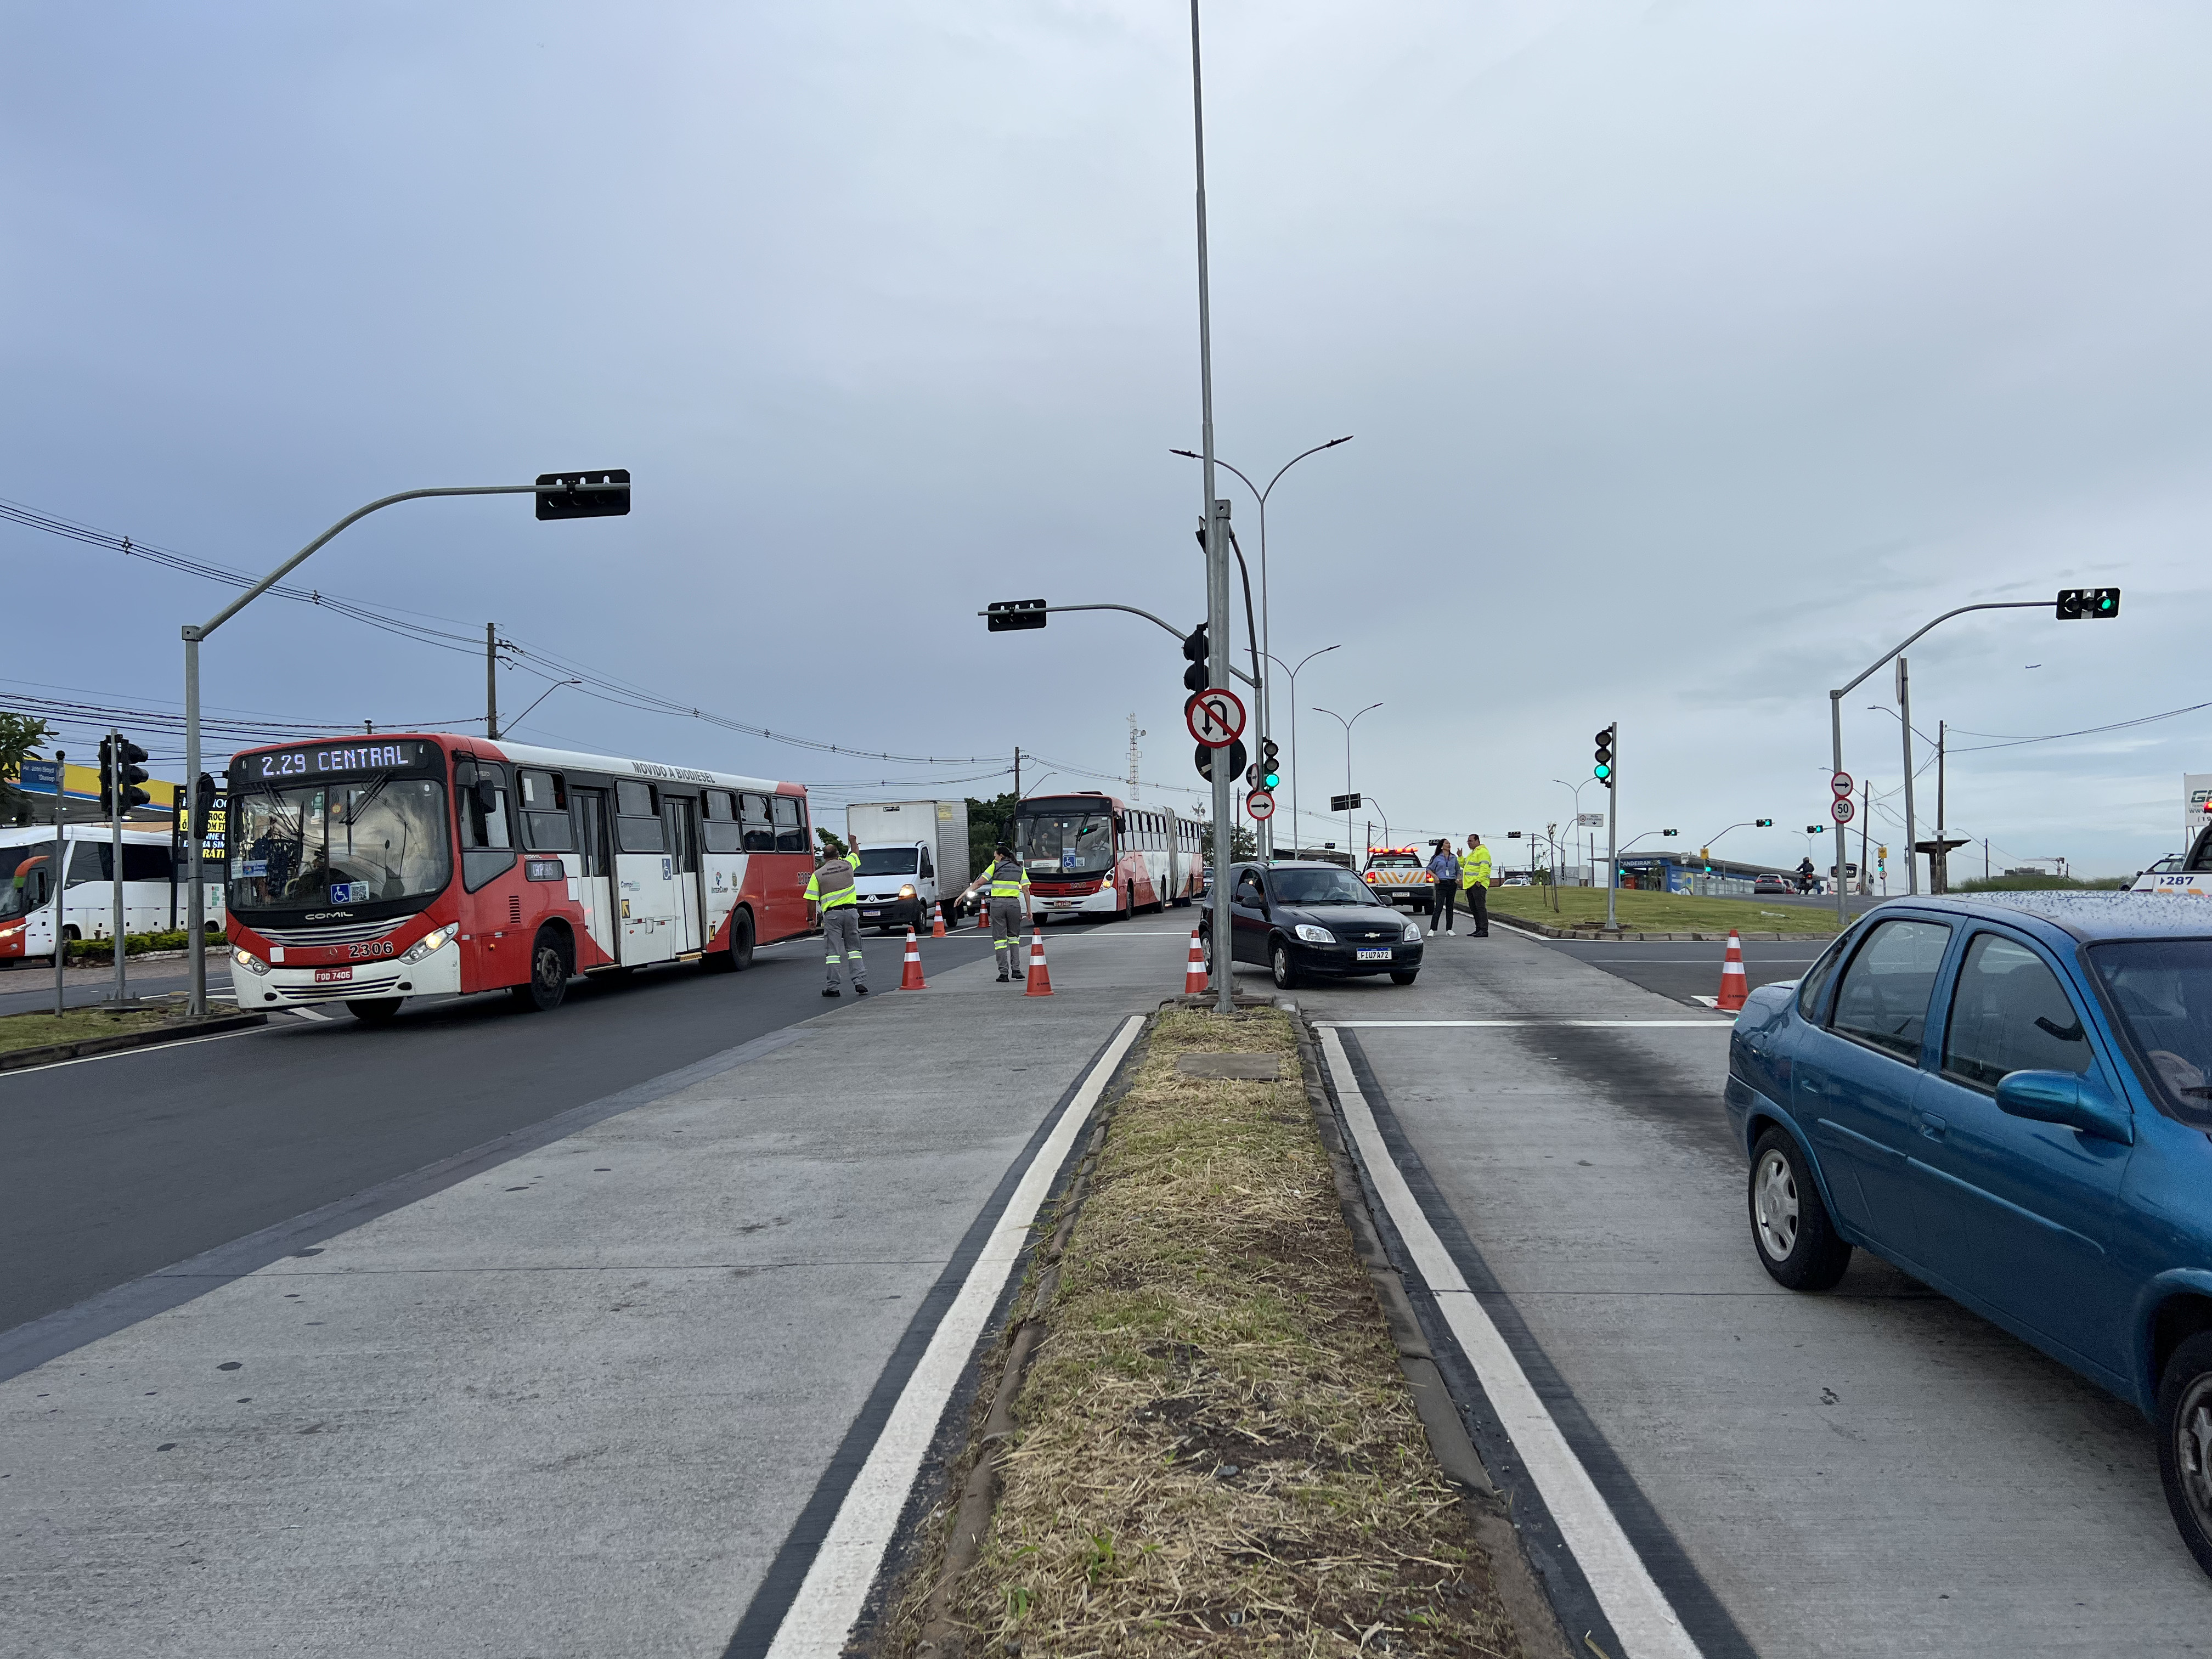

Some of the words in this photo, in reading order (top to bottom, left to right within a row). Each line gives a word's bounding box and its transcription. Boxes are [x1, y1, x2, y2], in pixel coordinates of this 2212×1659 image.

[262, 754, 306, 776] 2.29
[318, 746, 409, 771] CENTRAL
[631, 761, 667, 777] MOVIDO
[668, 767, 676, 778] A
[675, 768, 715, 783] BIODIESEL
[1838, 803, 1849, 814] 50
[2166, 876, 2194, 885] 287
[305, 911, 353, 920] COMIL
[348, 941, 393, 958] 2306
